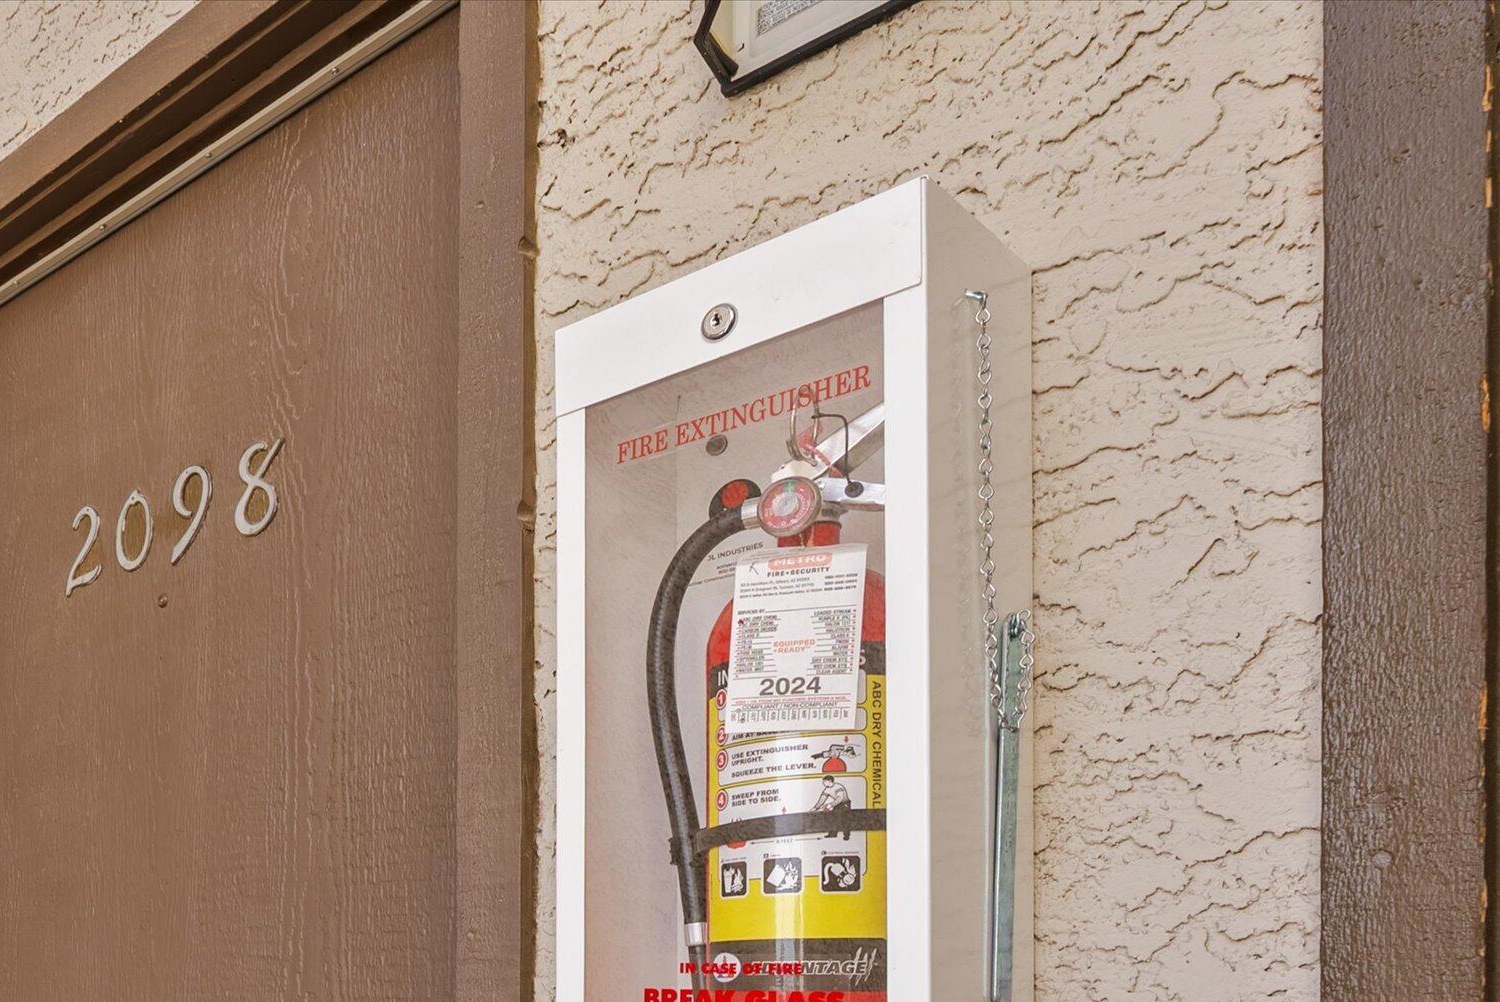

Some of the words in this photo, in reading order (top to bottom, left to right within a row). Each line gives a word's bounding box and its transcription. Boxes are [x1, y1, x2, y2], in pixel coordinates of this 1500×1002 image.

[617, 428, 668, 464] FIRE
[675, 365, 871, 447] EXTINGUISHER
[65, 437, 285, 598] 2098
[718, 541, 764, 558] INDUSTRIES
[773, 554, 827, 566] METRO
[773, 639, 816, 648] EQUIPPED
[760, 677, 821, 696] 2024
[872, 681, 882, 708] ABC
[872, 712, 882, 737] DRY
[731, 752, 744, 760] USE
[746, 744, 808, 758] EXTINGUISHER
[731, 756, 764, 766] UPRIGHT.
[731, 767, 764, 778] SQUEEZE
[766, 765, 783, 773] THE
[785, 762, 817, 770] LEVER.
[872, 741, 882, 807] CHEMICAL
[731, 791, 755, 800] SWEEP
[756, 789, 779, 797] FROM
[731, 799, 748, 807] SIDE
[680, 963, 696, 974] IN
[702, 963, 737, 975] CASE
[742, 963, 764, 975] OF
[769, 962, 802, 975] FIRE
